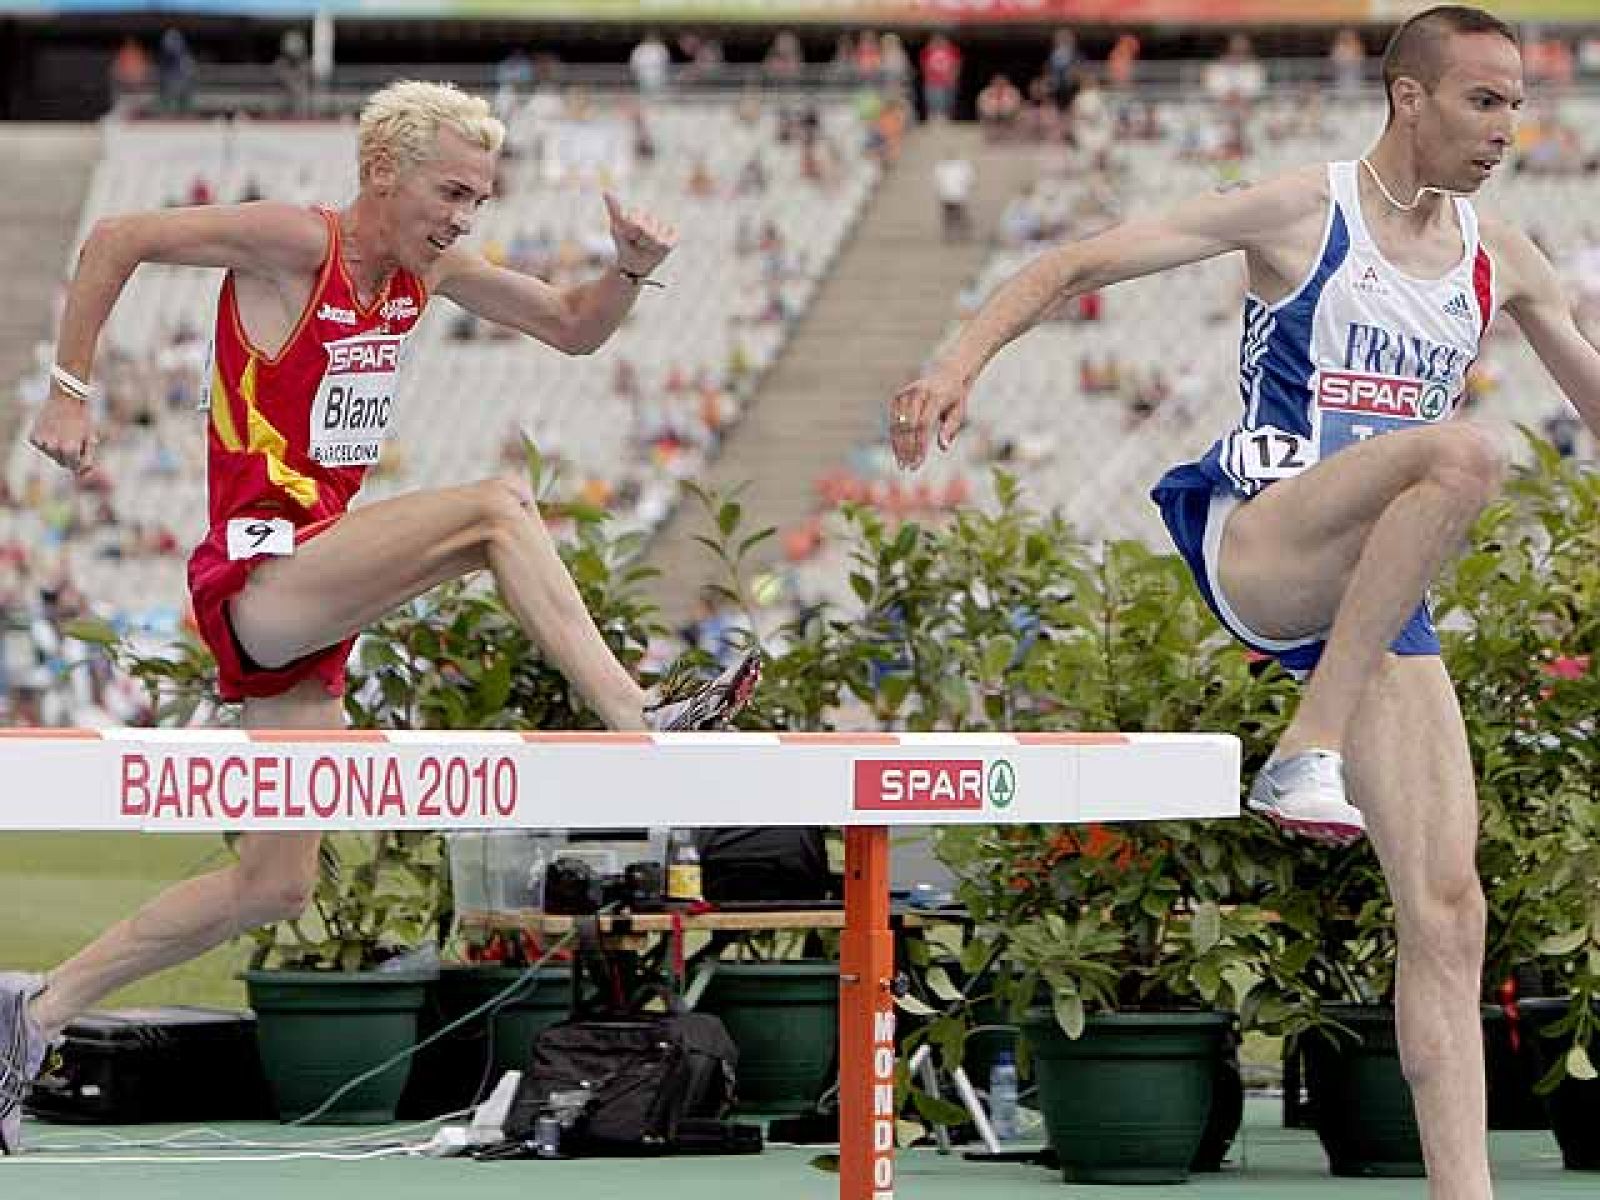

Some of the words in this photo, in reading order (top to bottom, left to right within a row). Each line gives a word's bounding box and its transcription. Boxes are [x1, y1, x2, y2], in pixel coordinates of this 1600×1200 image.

[332, 344, 397, 370] SPAR
[1321, 377, 1420, 412] SPAR
[1251, 434, 1305, 468] 12
[244, 523, 276, 549] 9
[119, 754, 406, 818] BARCELONA
[416, 756, 519, 817] 2010
[880, 769, 981, 801] SPAR
[873, 1012, 897, 1190] MONDO
